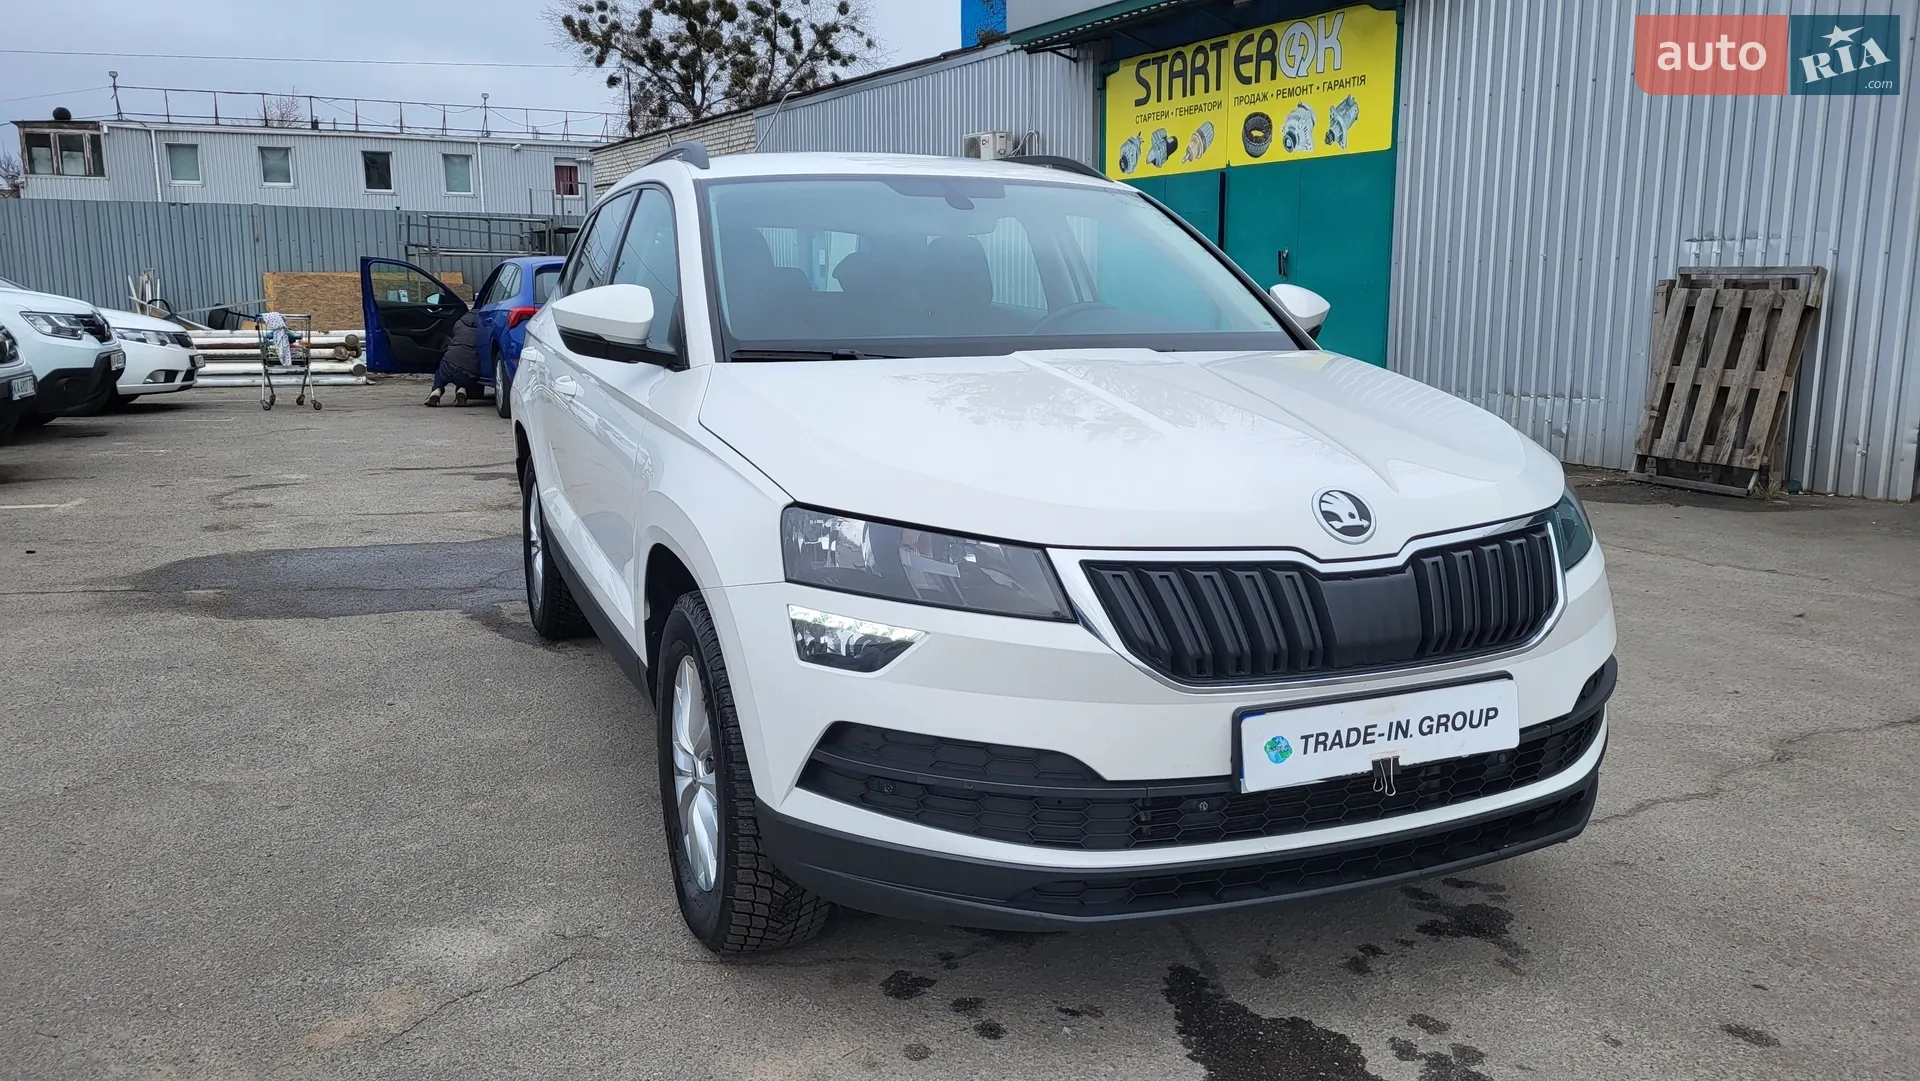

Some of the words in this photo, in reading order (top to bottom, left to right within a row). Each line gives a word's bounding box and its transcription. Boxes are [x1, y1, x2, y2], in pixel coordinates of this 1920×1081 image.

[1233, 91, 1269, 107] ПРОДАЖ
[1276, 84, 1314, 99] РЕМОНТ
[1322, 74, 1366, 92] ГАРАНТІЯ
[1135, 109, 1170, 124] СТАРТЕРИ
[1175, 100, 1223, 117] ГЕНЕРАТОРИ
[1418, 706, 1499, 738] GROUP
